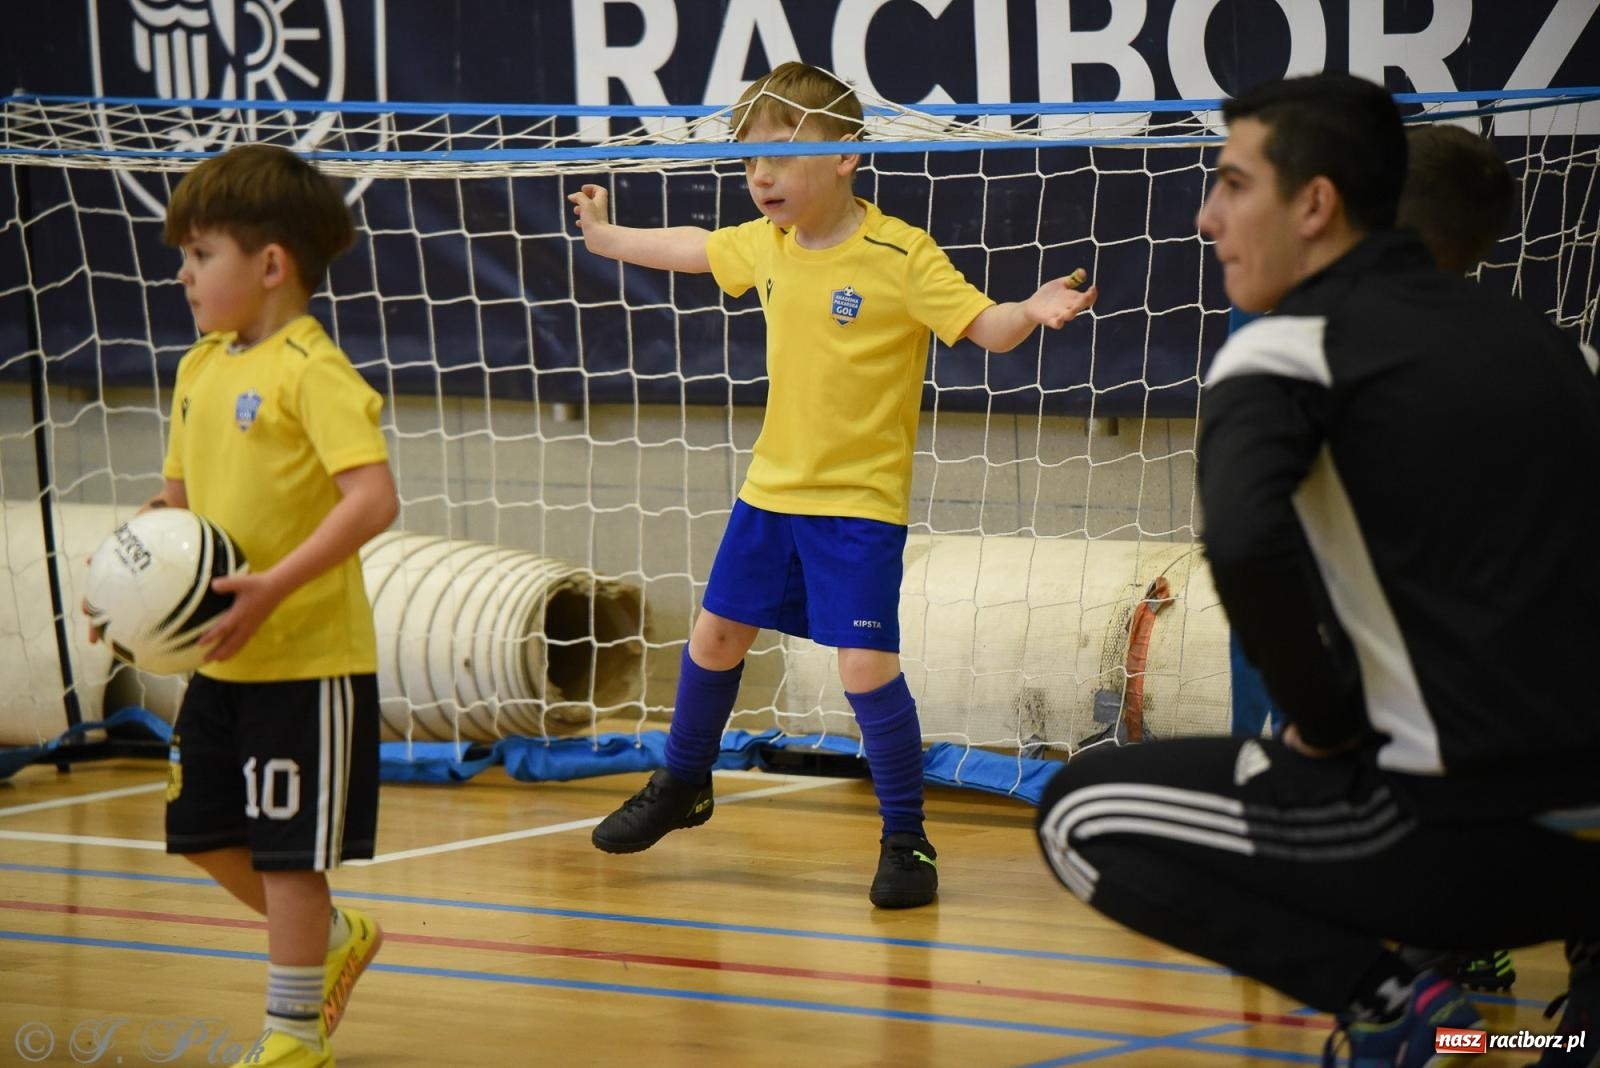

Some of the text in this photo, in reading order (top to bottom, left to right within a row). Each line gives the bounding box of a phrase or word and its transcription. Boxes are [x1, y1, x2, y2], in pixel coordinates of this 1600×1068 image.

[836, 306, 854, 316] GOL
[853, 619, 882, 629] KIPSTA
[243, 756, 301, 820] 10
